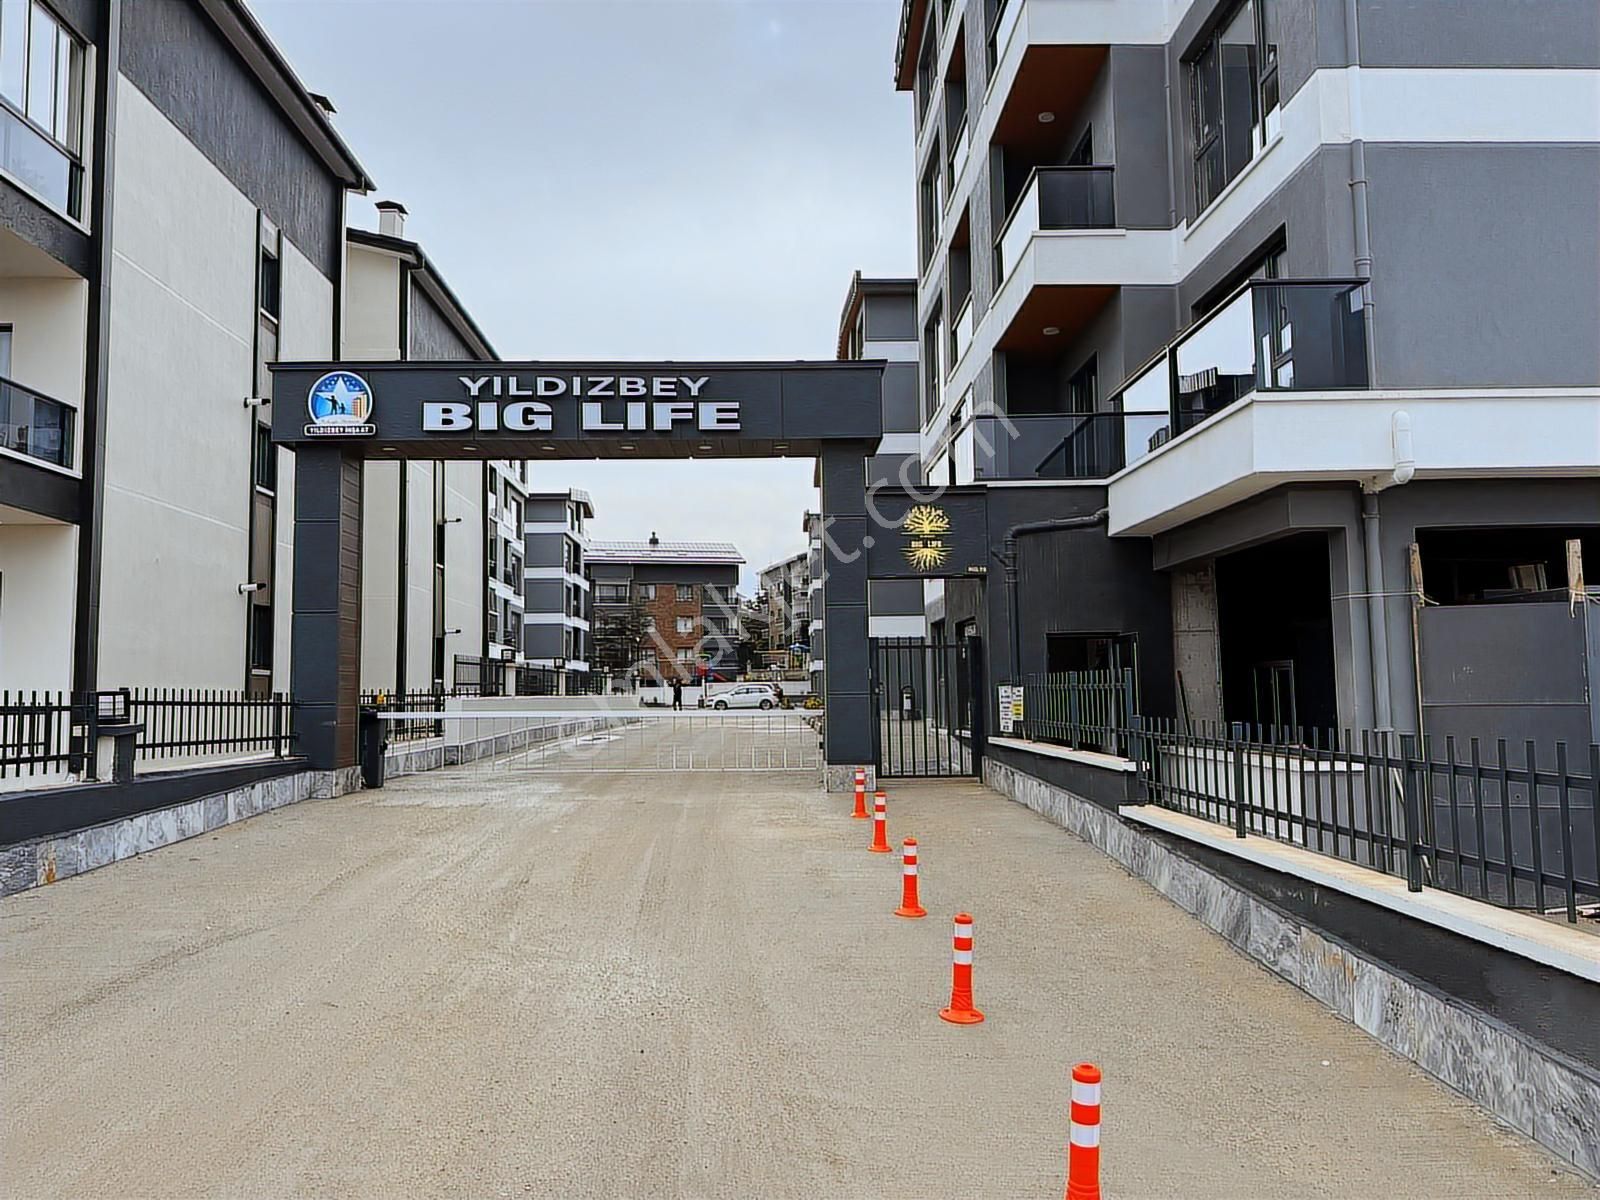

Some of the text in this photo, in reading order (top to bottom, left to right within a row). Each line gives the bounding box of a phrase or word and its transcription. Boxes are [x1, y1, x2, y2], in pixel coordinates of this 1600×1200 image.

[459, 376, 710, 397] YILDIZBEY
[422, 402, 742, 432] BIG LIFE
